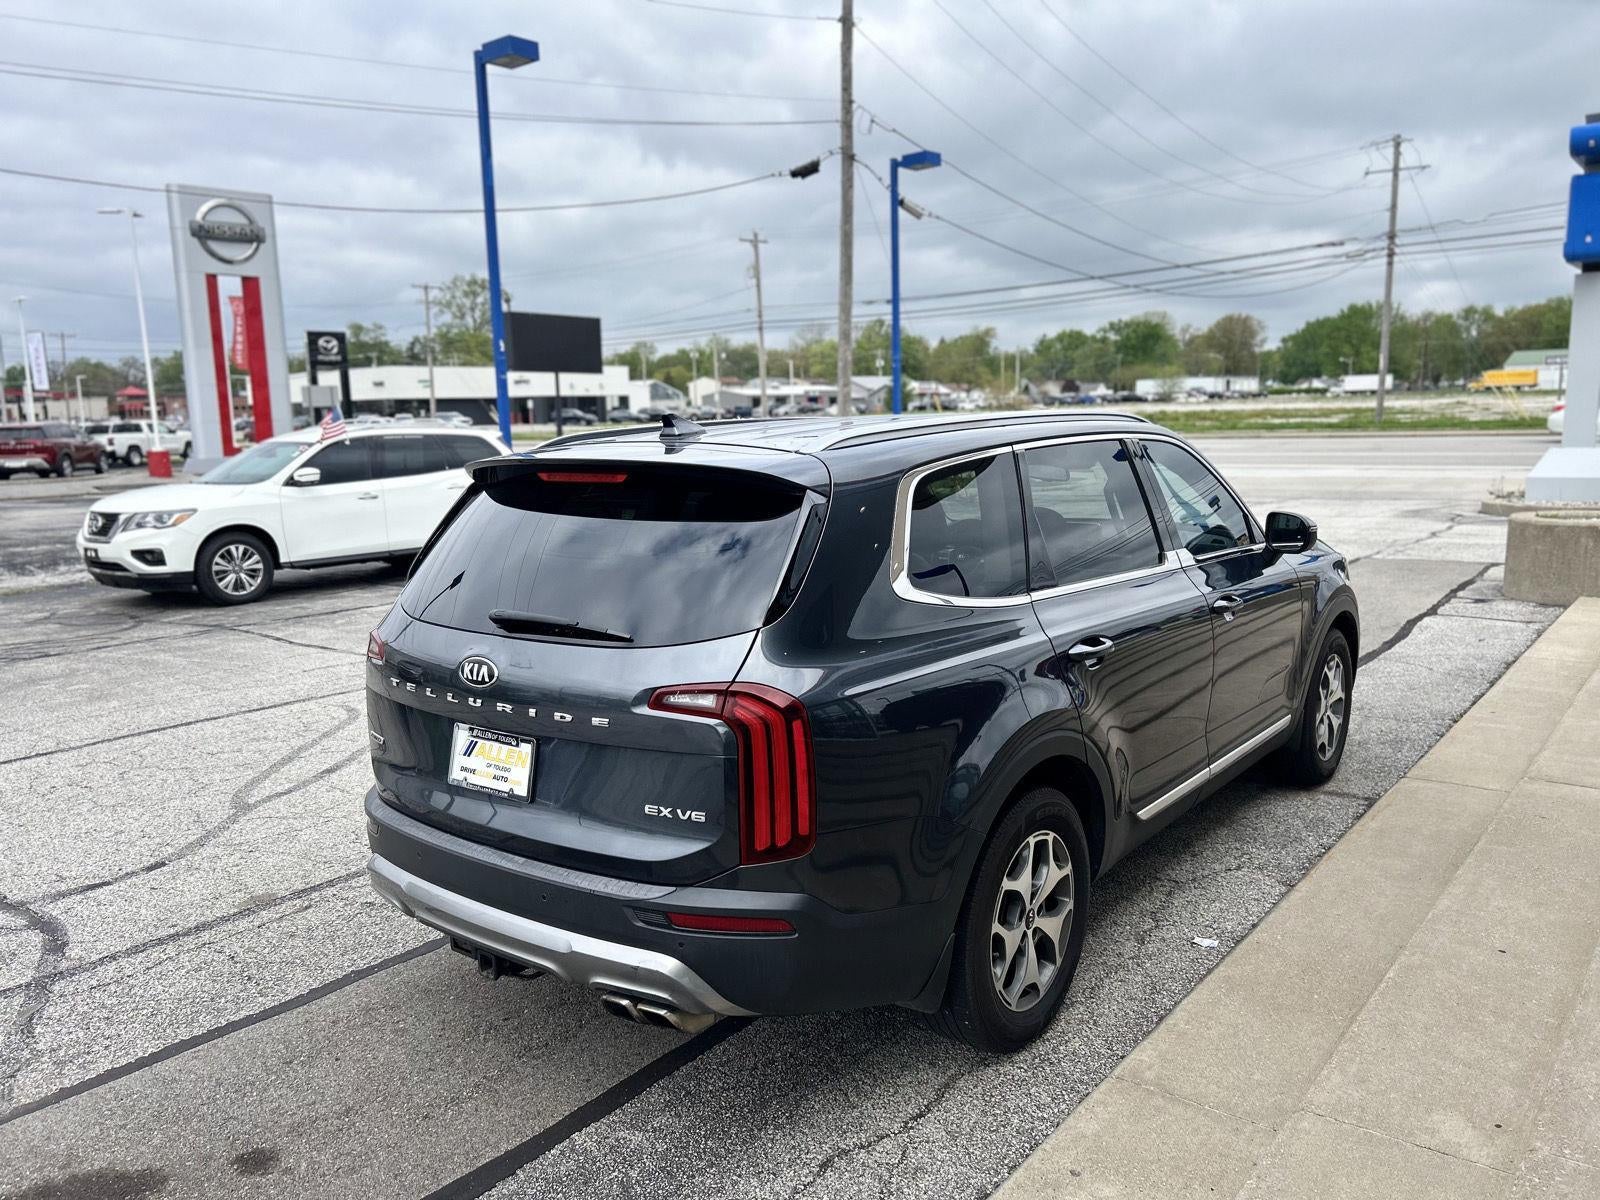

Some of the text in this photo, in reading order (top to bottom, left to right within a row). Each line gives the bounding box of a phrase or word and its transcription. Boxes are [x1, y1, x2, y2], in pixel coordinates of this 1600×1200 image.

[463, 662, 490, 682] KIA
[390, 677, 610, 727] TELLURIDE
[477, 730, 492, 740] ALLEN
[475, 742, 528, 768] ALLEN
[644, 804, 706, 823] EX V6
